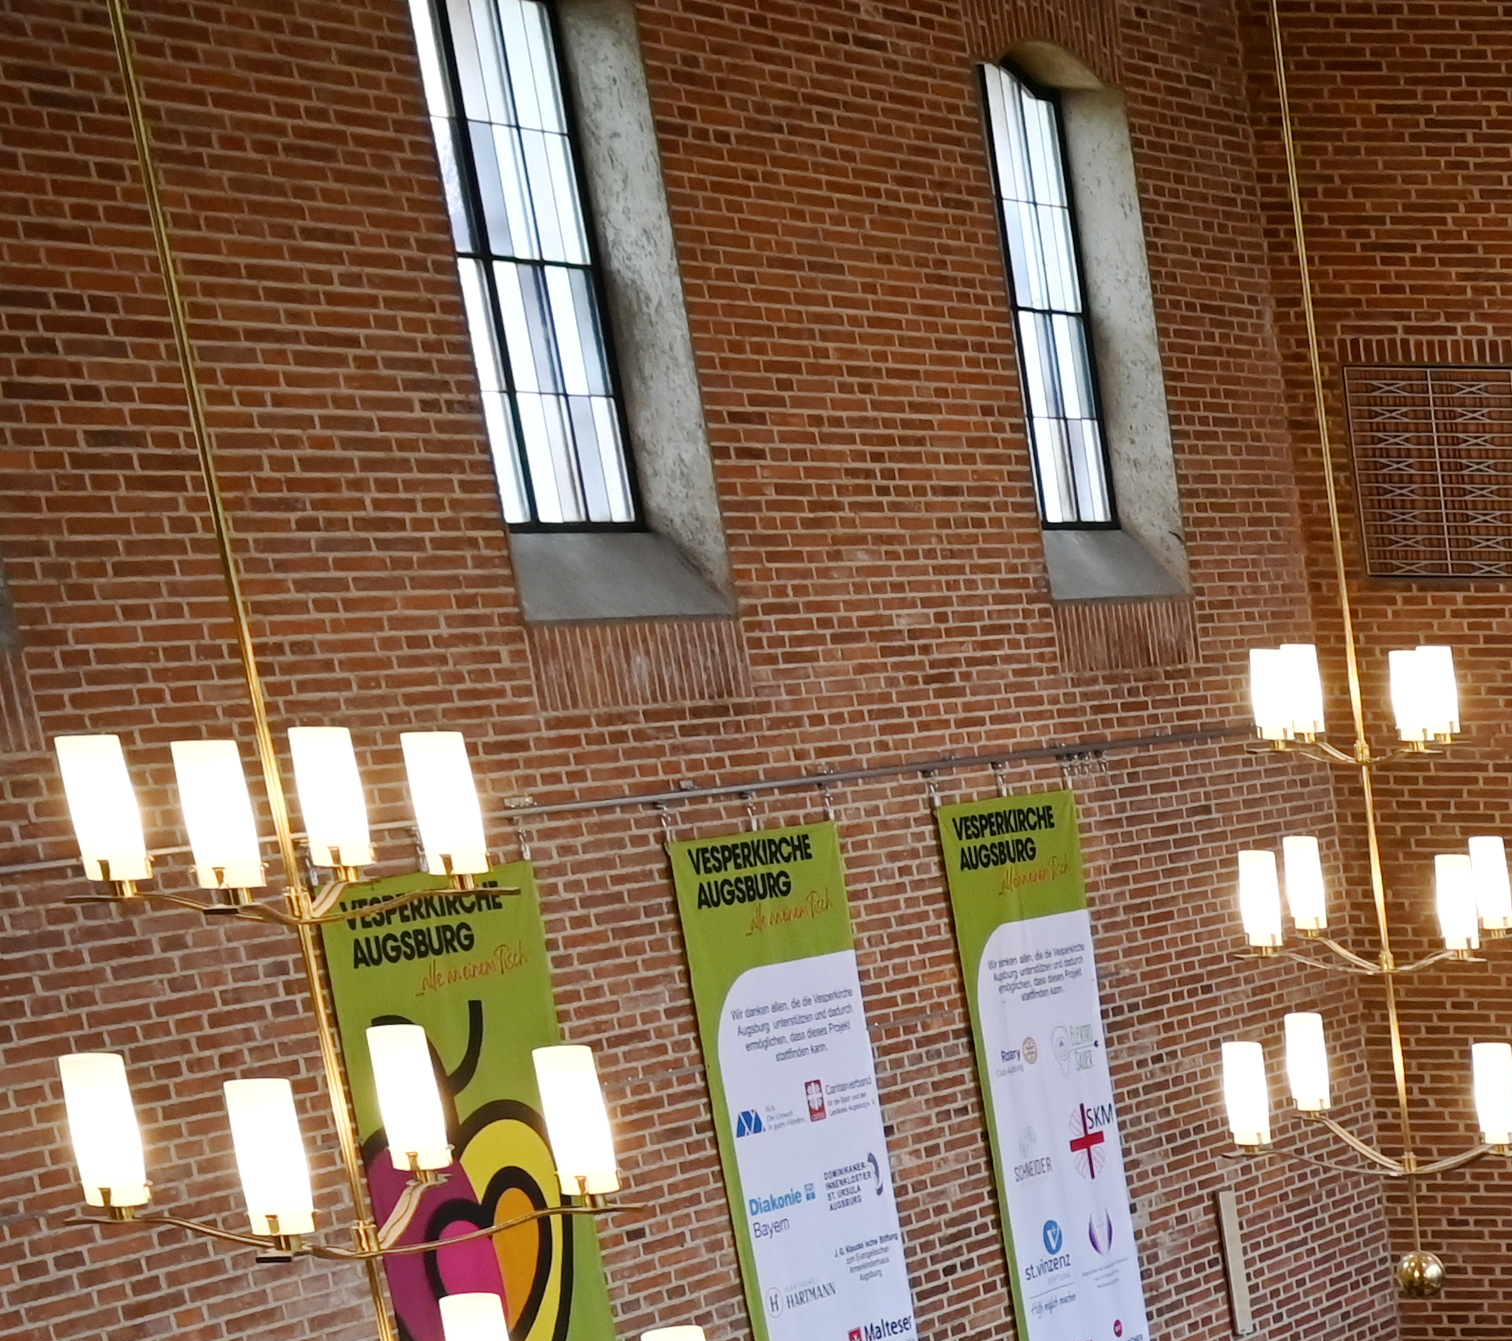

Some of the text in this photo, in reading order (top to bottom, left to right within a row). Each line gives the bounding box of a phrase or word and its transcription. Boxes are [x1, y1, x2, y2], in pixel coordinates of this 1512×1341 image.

[952, 805, 1055, 841] VESPERKIRCHE
[687, 834, 813, 875] VESPERKIRCHE
[960, 837, 1037, 871] AUGSBURG
[340, 881, 503, 930] VESPERKIRCHE
[697, 870, 792, 910] AUGSBURG
[353, 922, 475, 969] AUGSBURG
[1086, 1103, 1114, 1129] SKM
[1014, 1156, 1052, 1182] SCHNEIDER
[749, 1188, 802, 1216] Diakonie
[786, 1281, 836, 1309] HARTMANN
